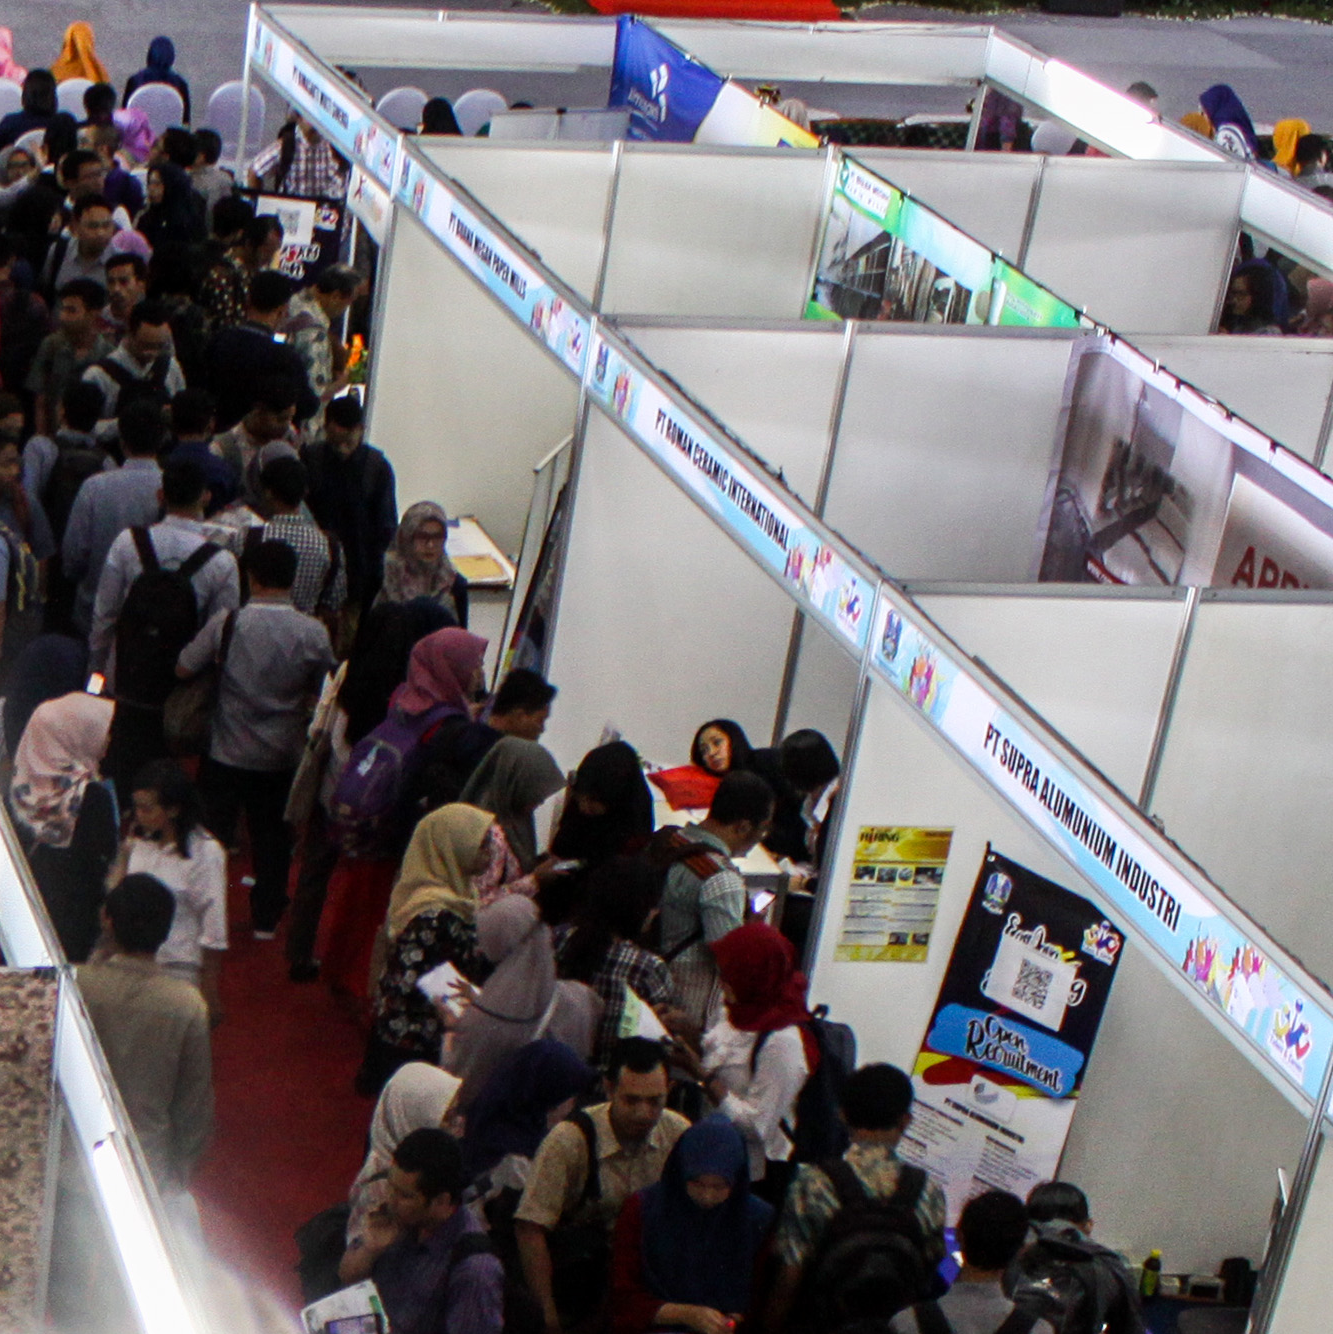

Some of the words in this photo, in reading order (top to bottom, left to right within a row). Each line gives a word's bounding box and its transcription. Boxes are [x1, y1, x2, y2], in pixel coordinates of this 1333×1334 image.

[492, 252, 510, 281] PAPER
[509, 269, 527, 300] MILLS
[655, 408, 666, 434] PT
[666, 418, 694, 460] ROMAN
[693, 443, 729, 493] CERAMIC
[728, 476, 789, 550] INTERNATIONAL
[984, 722, 1001, 757] PT
[1000, 738, 1040, 796] SUPRA
[1038, 777, 1118, 870] ALUMUNIUM
[1115, 850, 1182, 932] INDUSTRI
[966, 1020, 1061, 1092] Recruitment
[984, 1015, 1027, 1052] Open
